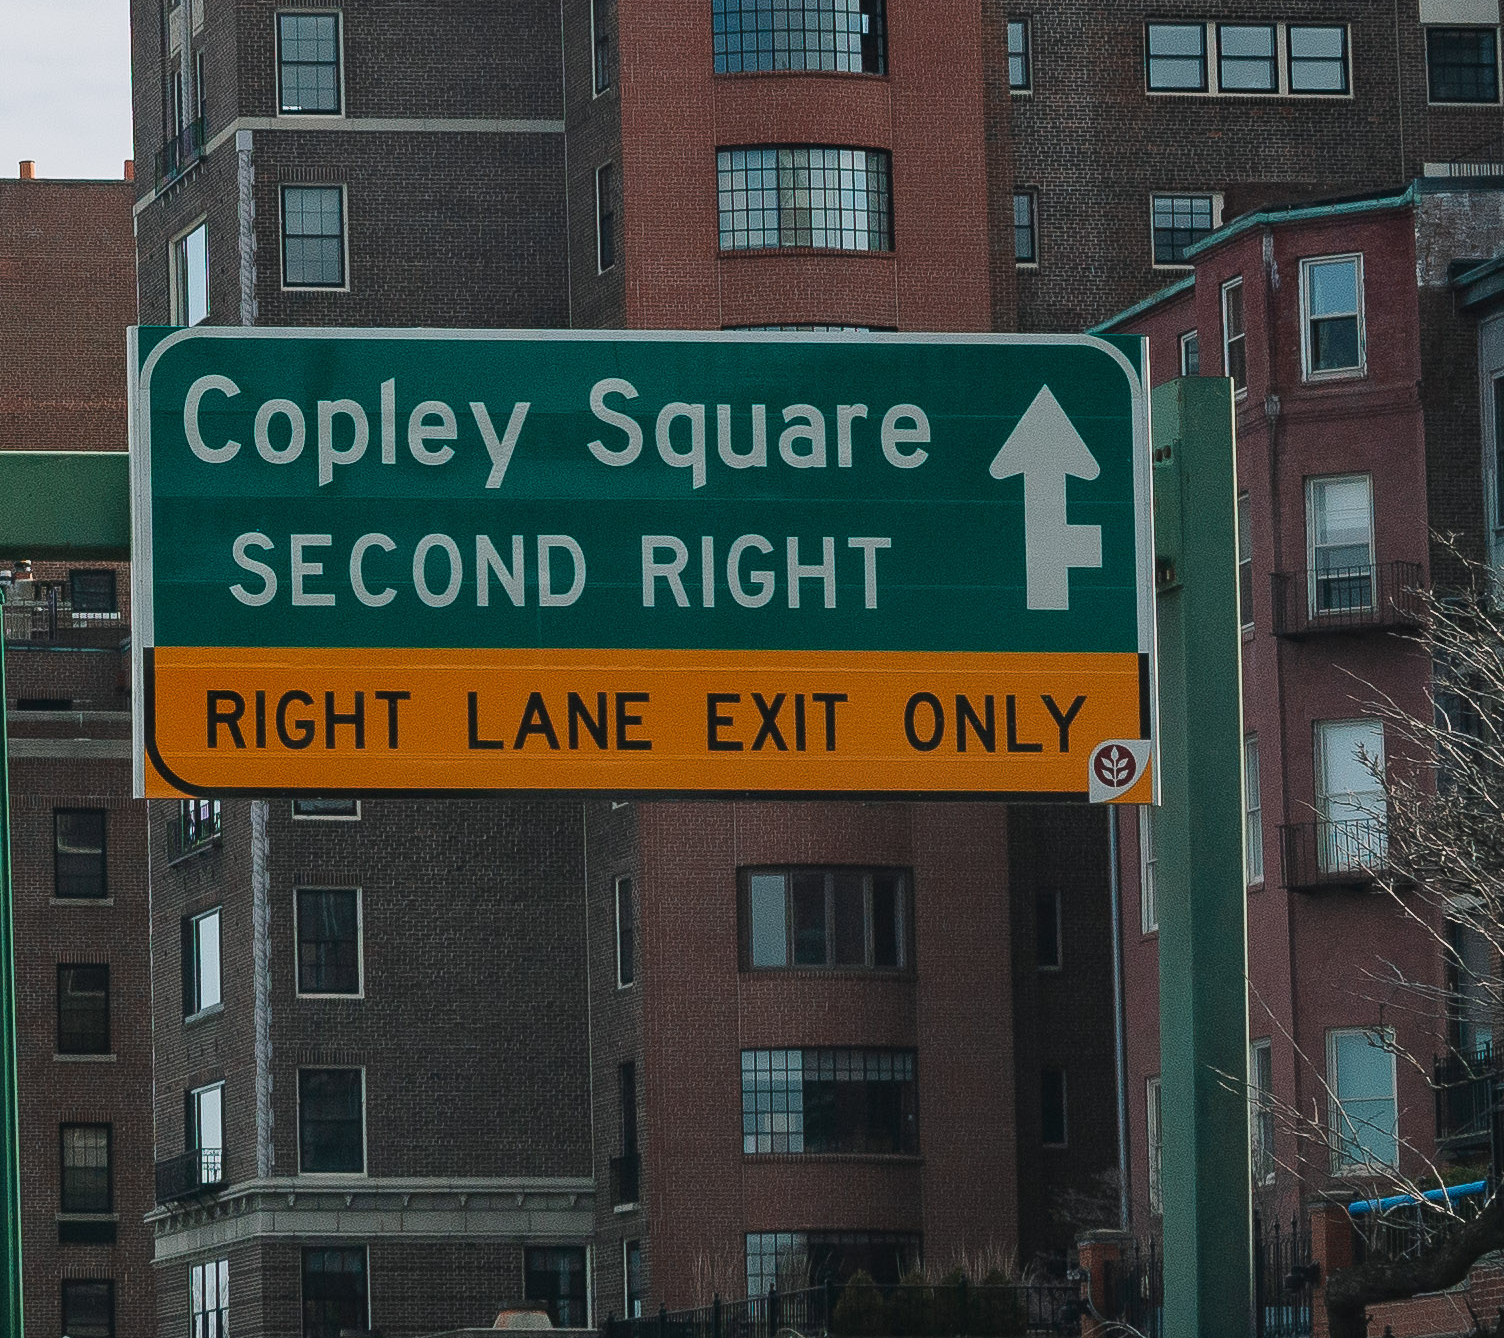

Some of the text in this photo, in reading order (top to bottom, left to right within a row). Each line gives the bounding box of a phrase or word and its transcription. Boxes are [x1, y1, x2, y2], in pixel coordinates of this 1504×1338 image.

[184, 375, 930, 489] Copley Square
[230, 532, 891, 609] SECOND RIGHT
[207, 690, 1086, 752] RIGHT LANE EXIT ONLY
